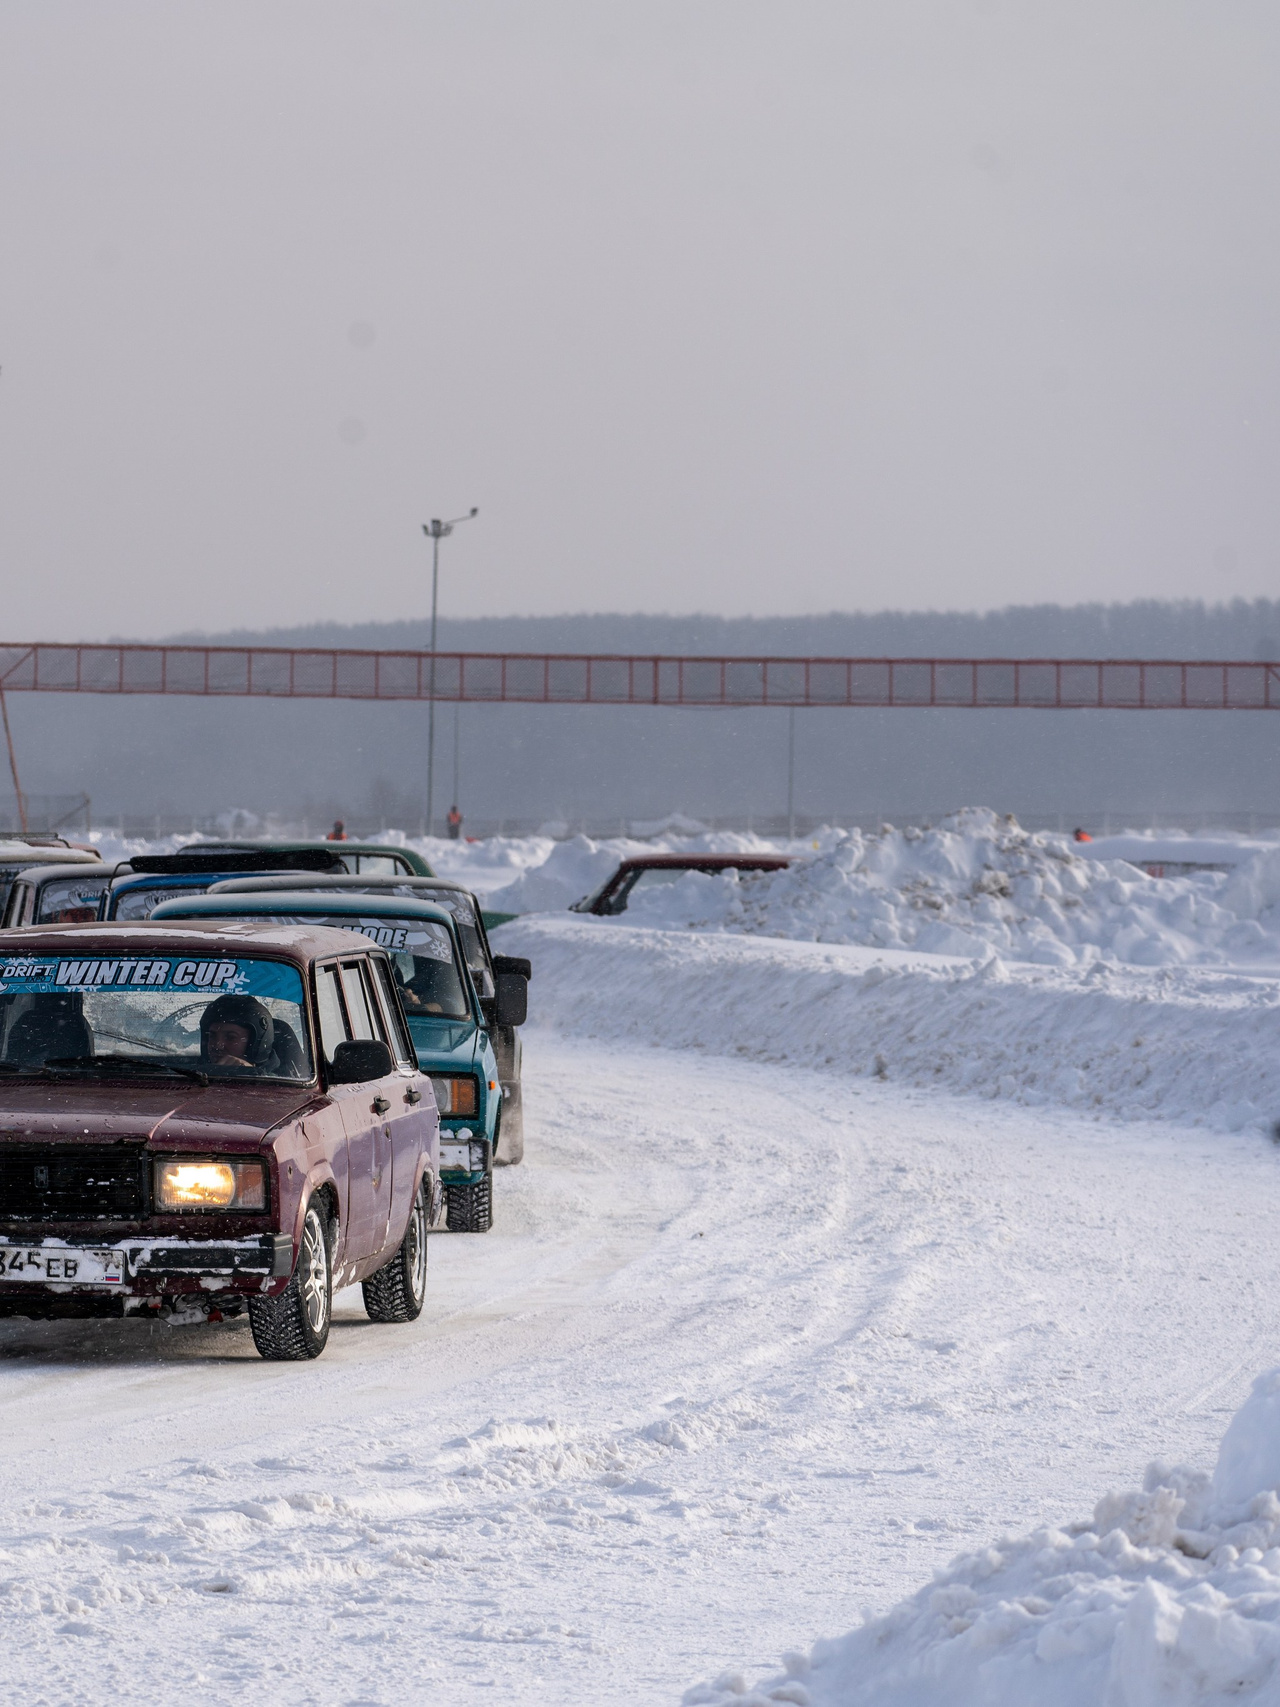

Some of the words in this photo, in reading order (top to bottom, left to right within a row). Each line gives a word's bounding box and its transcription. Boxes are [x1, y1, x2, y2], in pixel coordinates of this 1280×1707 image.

[2, 964, 56, 977] DRIFT
[55, 961, 170, 985] WINTER
[172, 962, 237, 986] CUP
